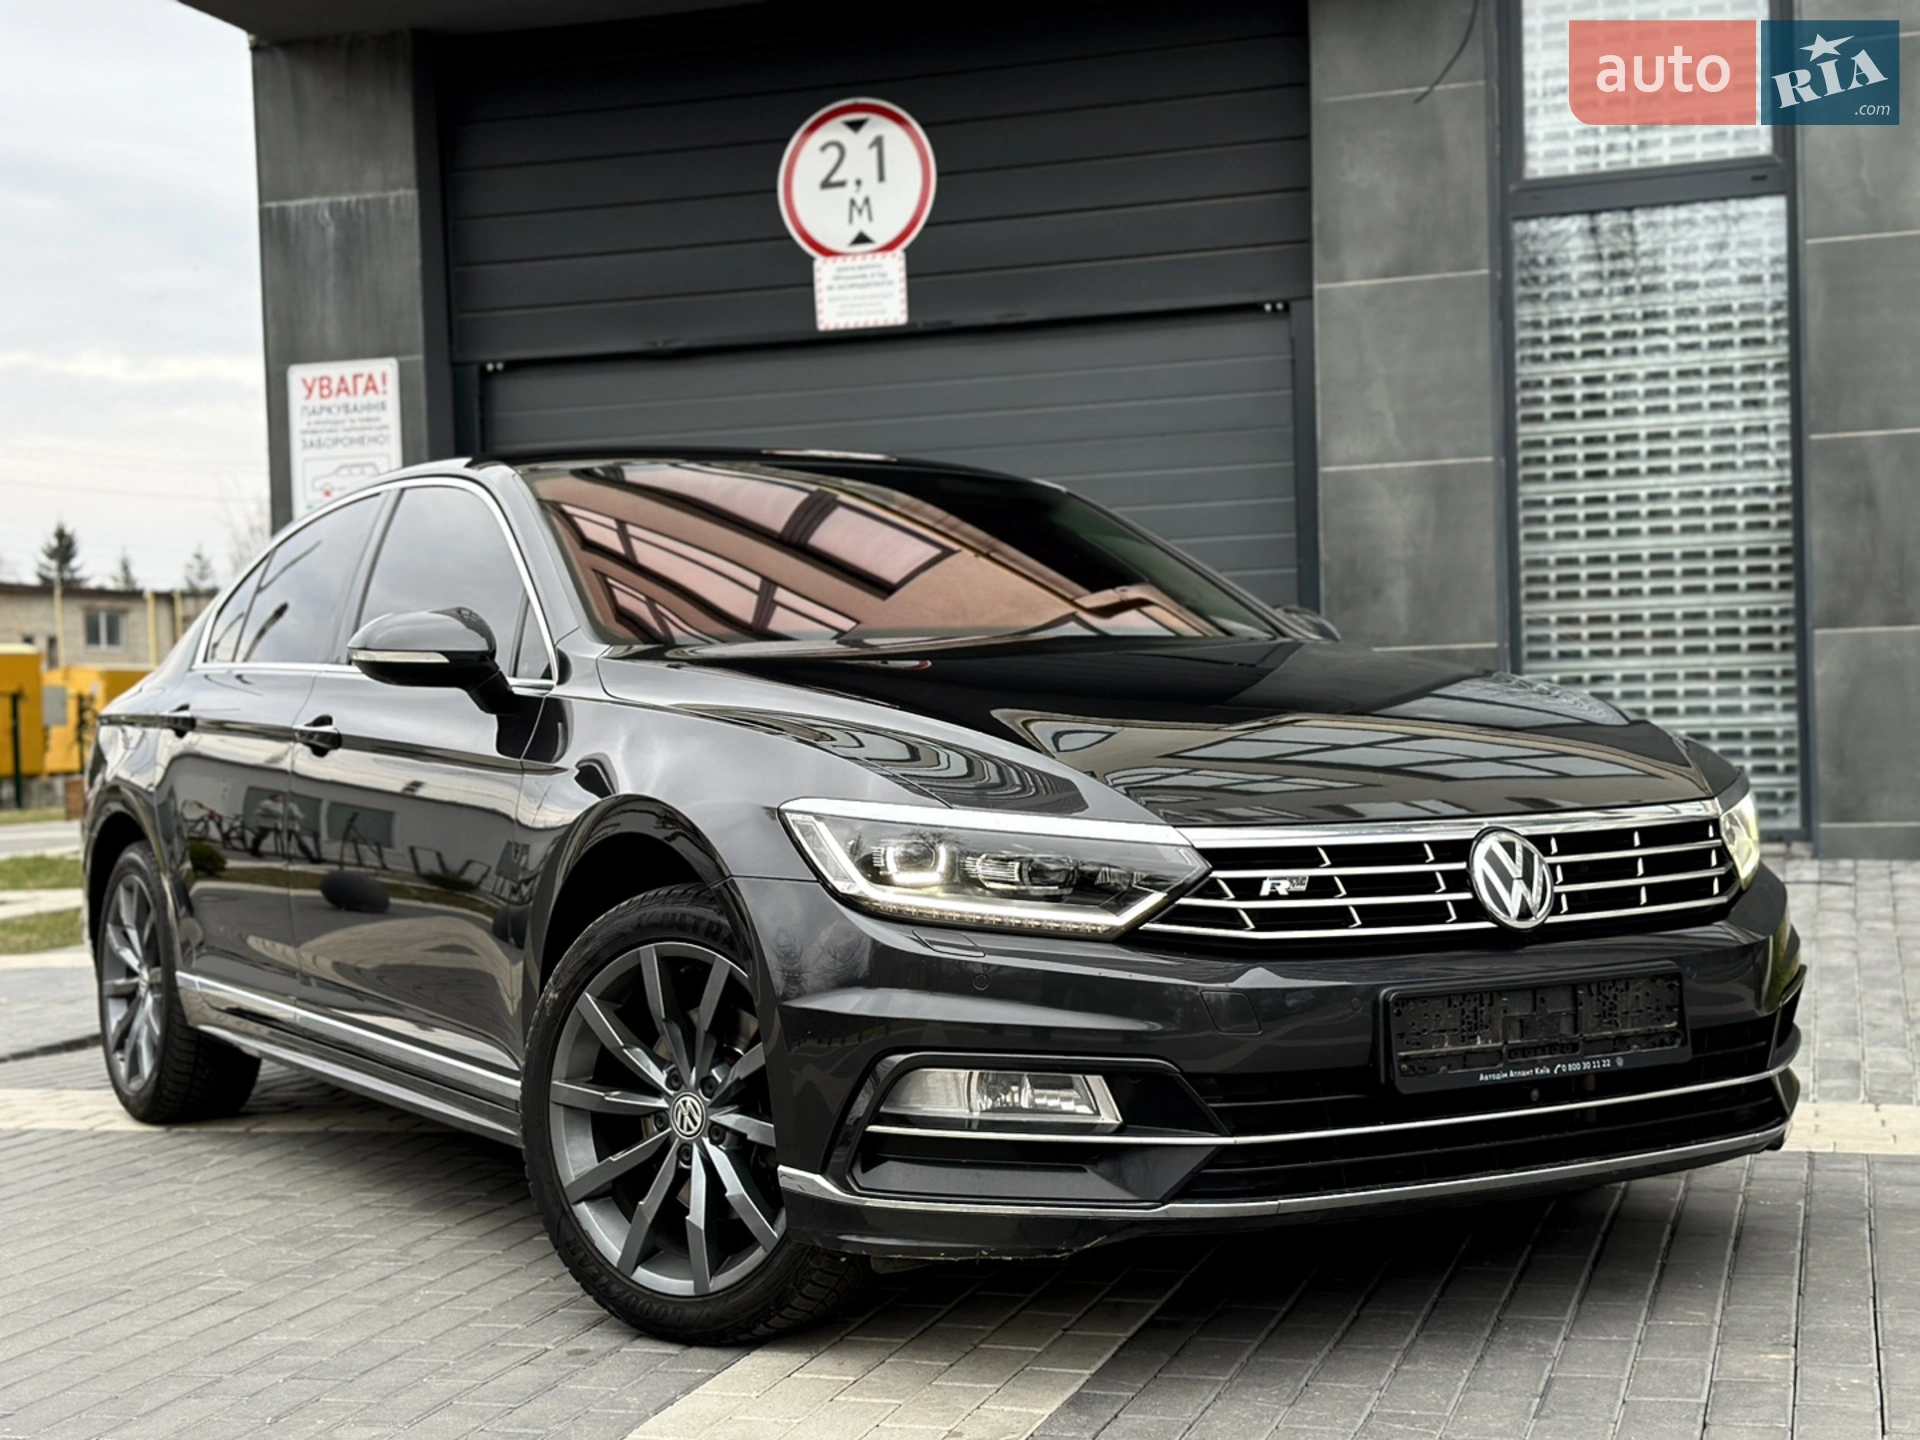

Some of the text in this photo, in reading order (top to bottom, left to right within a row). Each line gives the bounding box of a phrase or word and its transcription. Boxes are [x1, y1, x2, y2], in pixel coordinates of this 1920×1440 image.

[819, 134, 886, 192] 2,1
[301, 371, 388, 401] УВАГА!
[1509, 1069, 1533, 1078] Атлант
[1568, 1062, 1582, 1072] 800
[1582, 1061, 1591, 1070] 30
[1592, 1060, 1601, 1069] 11
[1602, 1059, 1611, 1068] 22
